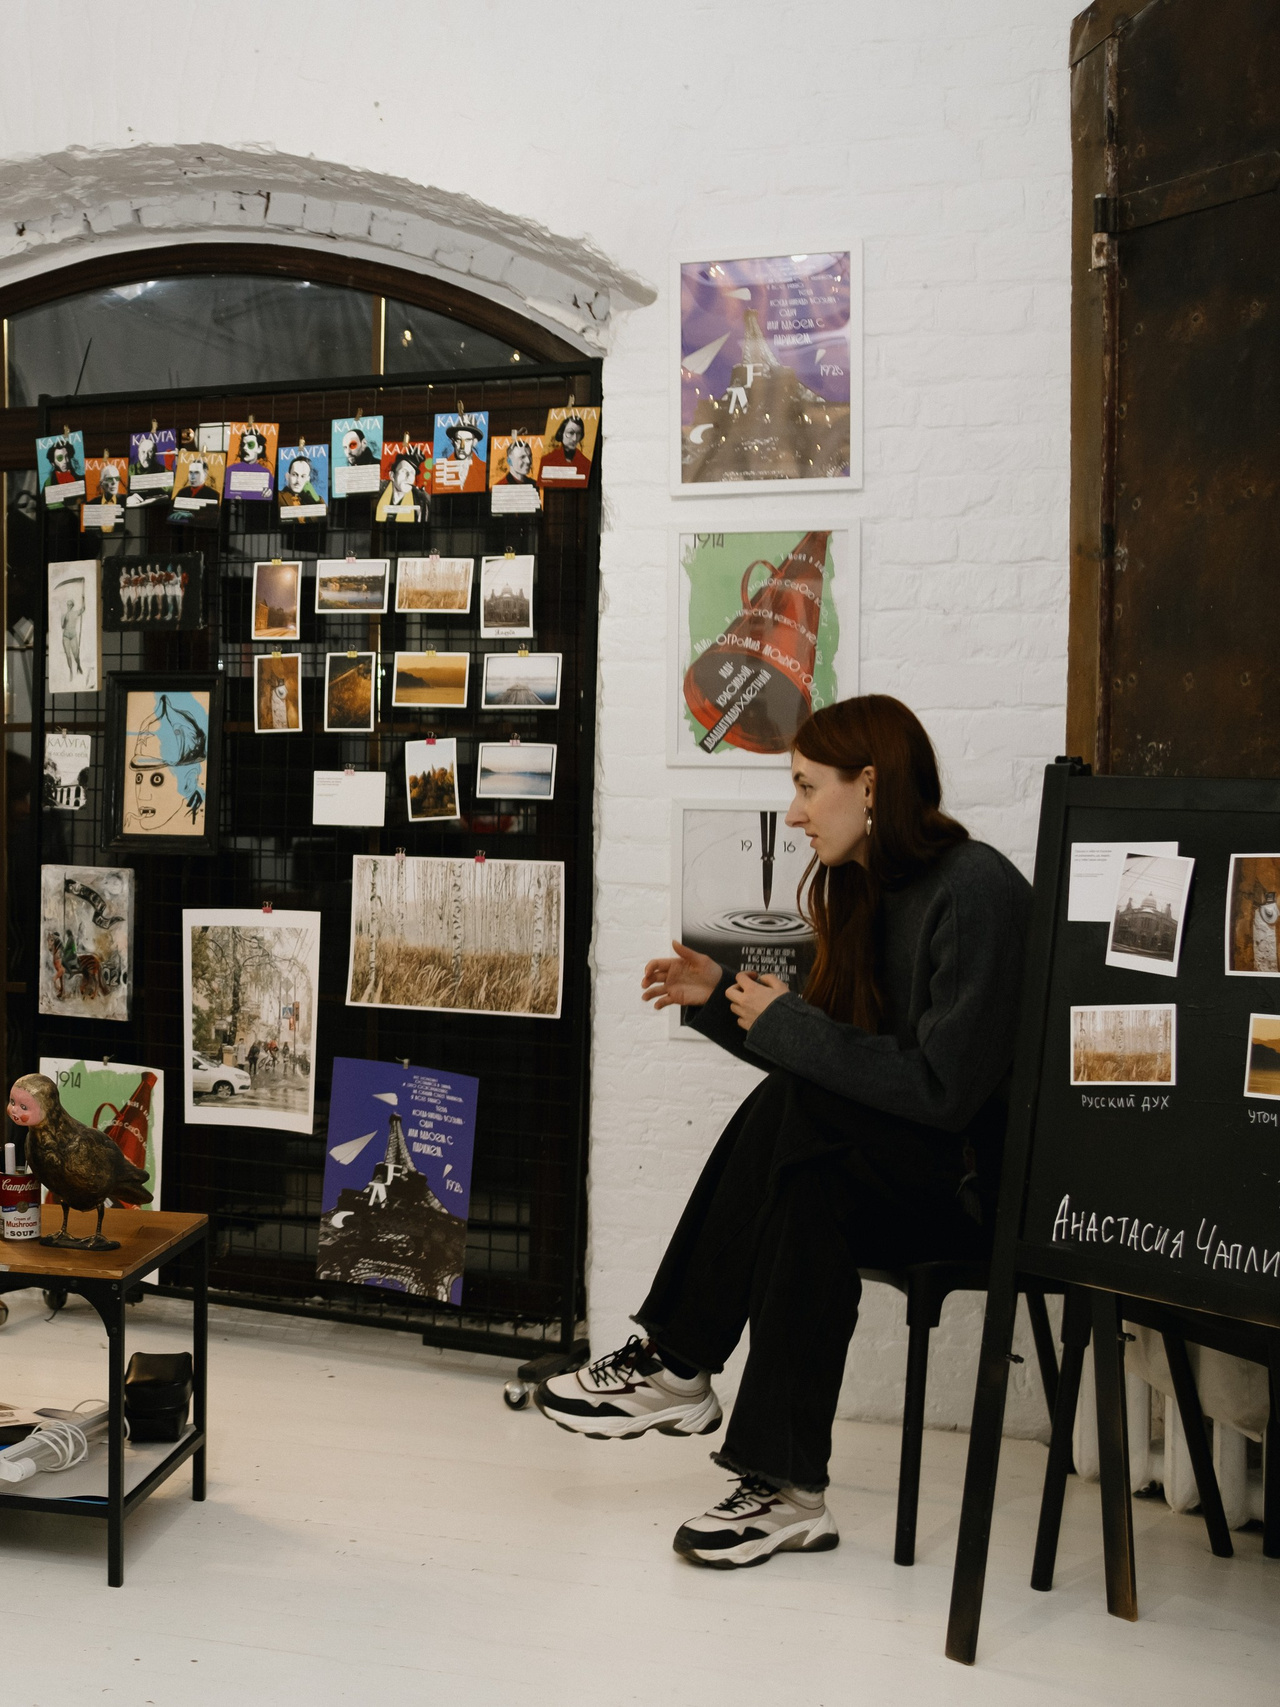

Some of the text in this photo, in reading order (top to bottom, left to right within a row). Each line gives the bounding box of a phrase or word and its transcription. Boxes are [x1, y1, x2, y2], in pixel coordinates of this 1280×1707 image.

[820, 364, 844, 377] 1928
[551, 408, 597, 420] КАЛУГА
[232, 423, 277, 435] КАЛУГА
[334, 417, 381, 432] КАЛУГА
[132, 431, 174, 446] КАЛУГА
[281, 445, 326, 460] КАЛУГА
[384, 443, 432, 455] КАЛУГА
[693, 532, 724, 549] 1914
[716, 633, 761, 651] ОГРОМИВ
[741, 839, 796, 853] 19 16
[55, 1070, 81, 1089] 1914
[1081, 1094, 1170, 1112] РУССКИЙ ДУХ
[1051, 1193, 1185, 1259] АНАСТАСИЯ
